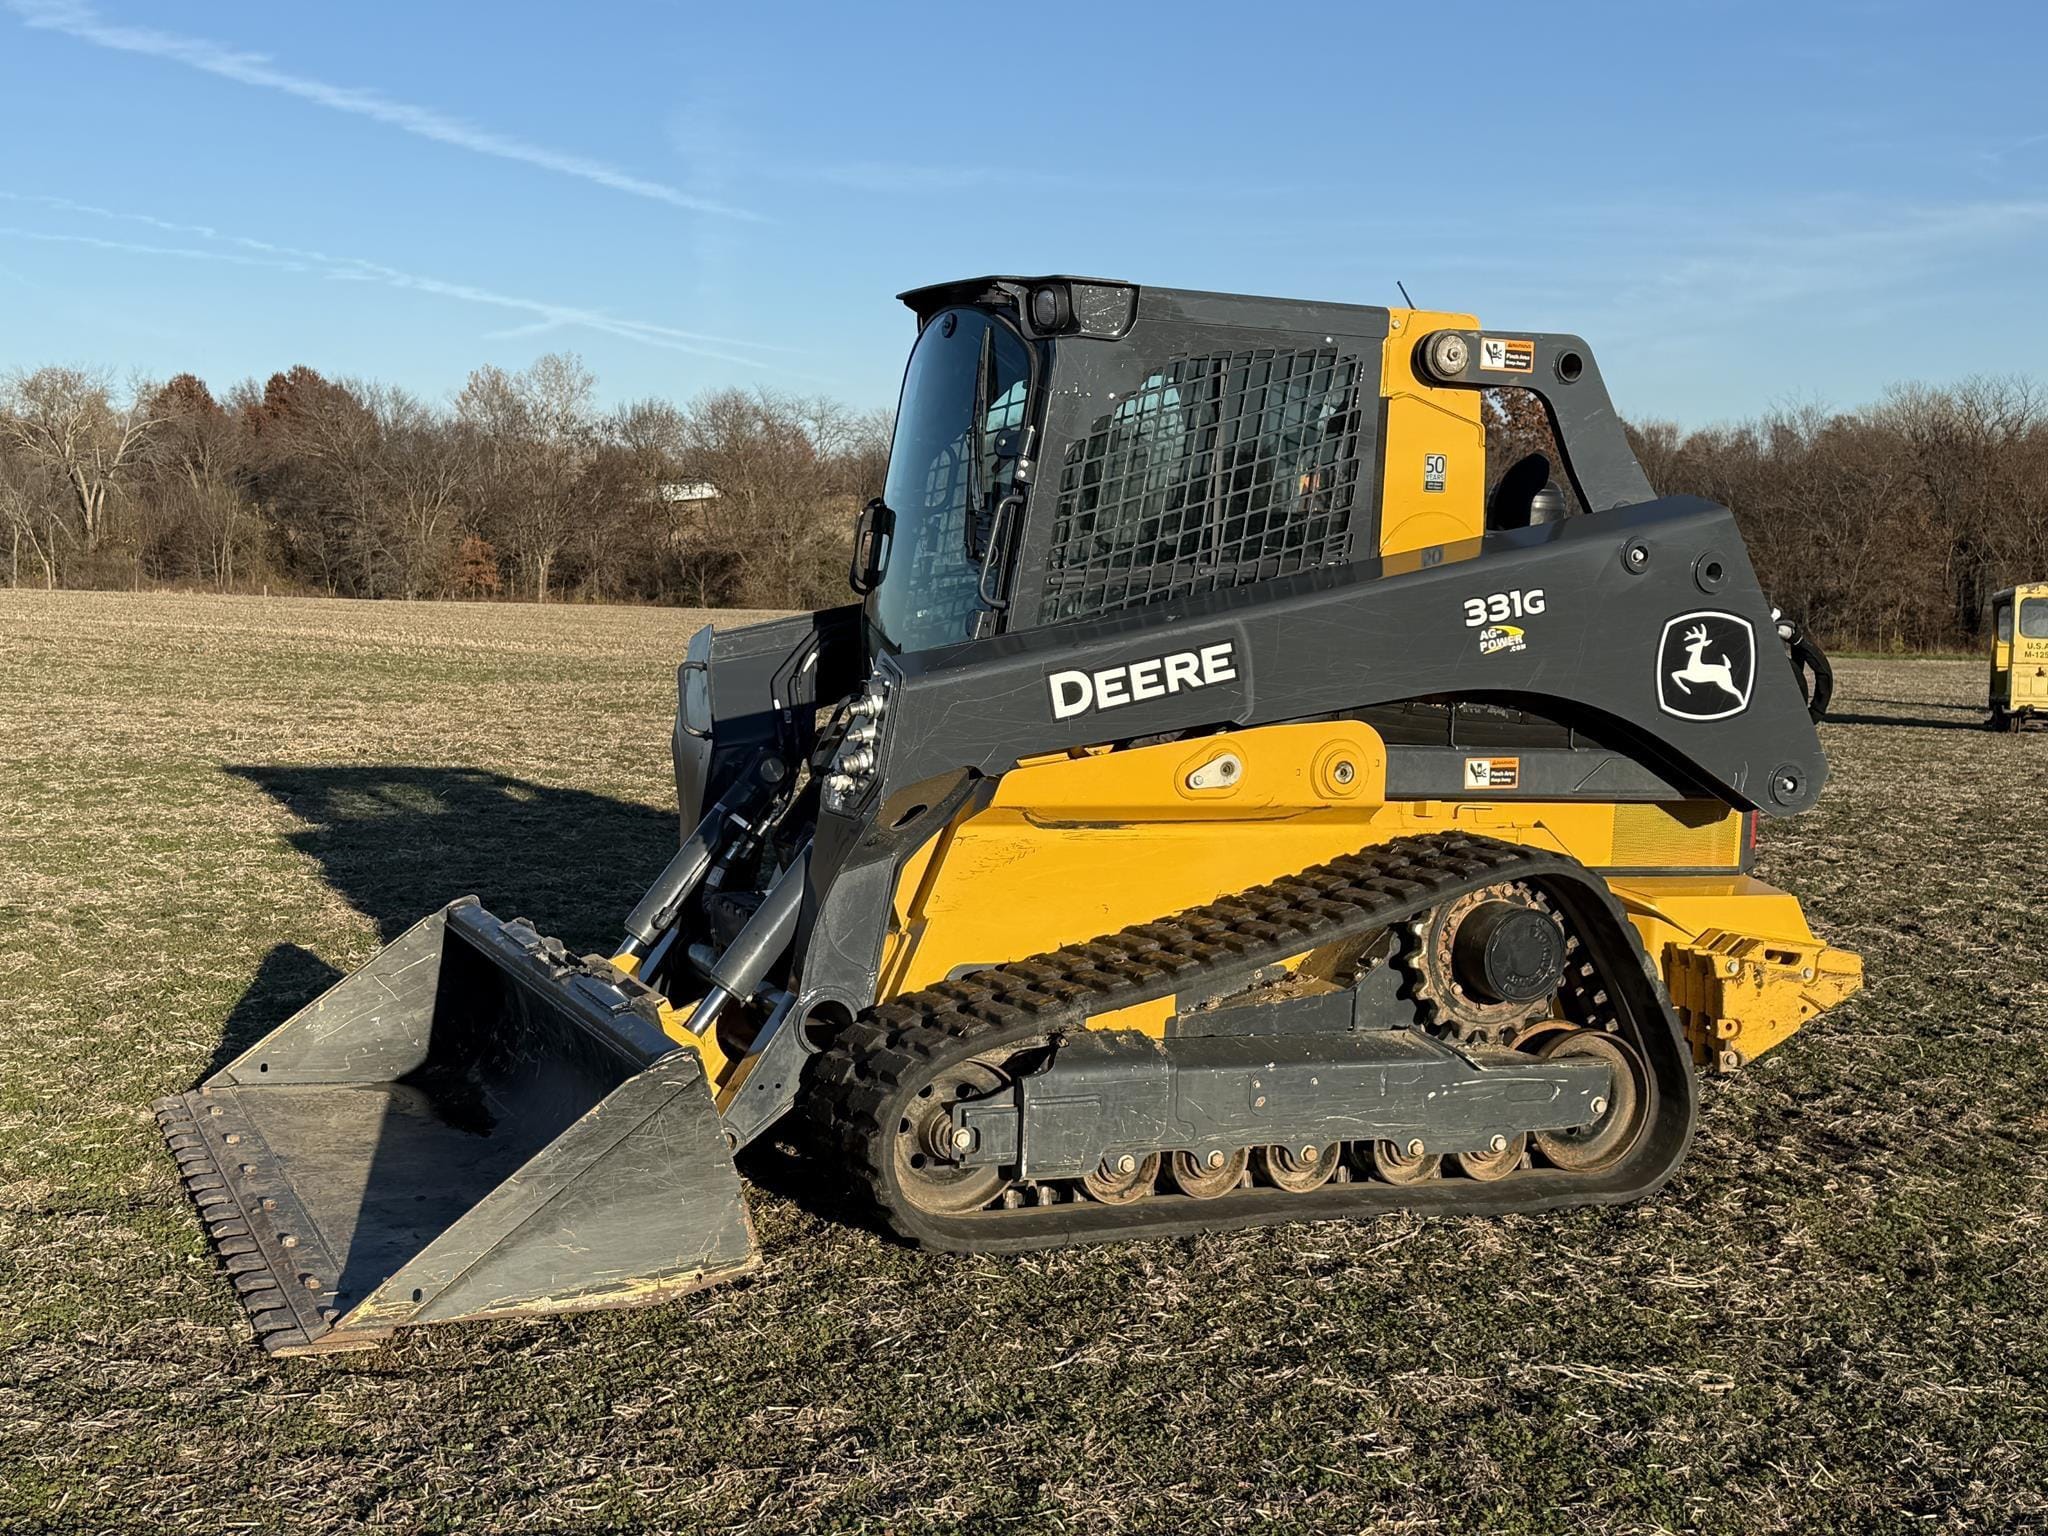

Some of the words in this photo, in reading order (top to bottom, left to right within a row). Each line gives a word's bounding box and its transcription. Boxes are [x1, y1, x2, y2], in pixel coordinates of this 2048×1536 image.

[1426, 456, 1445, 473] 50
[1464, 589, 1546, 627] 331G
[1480, 629, 1502, 641] AG-
[1480, 634, 1523, 652] POWER
[1049, 643, 1237, 719] DEERE
